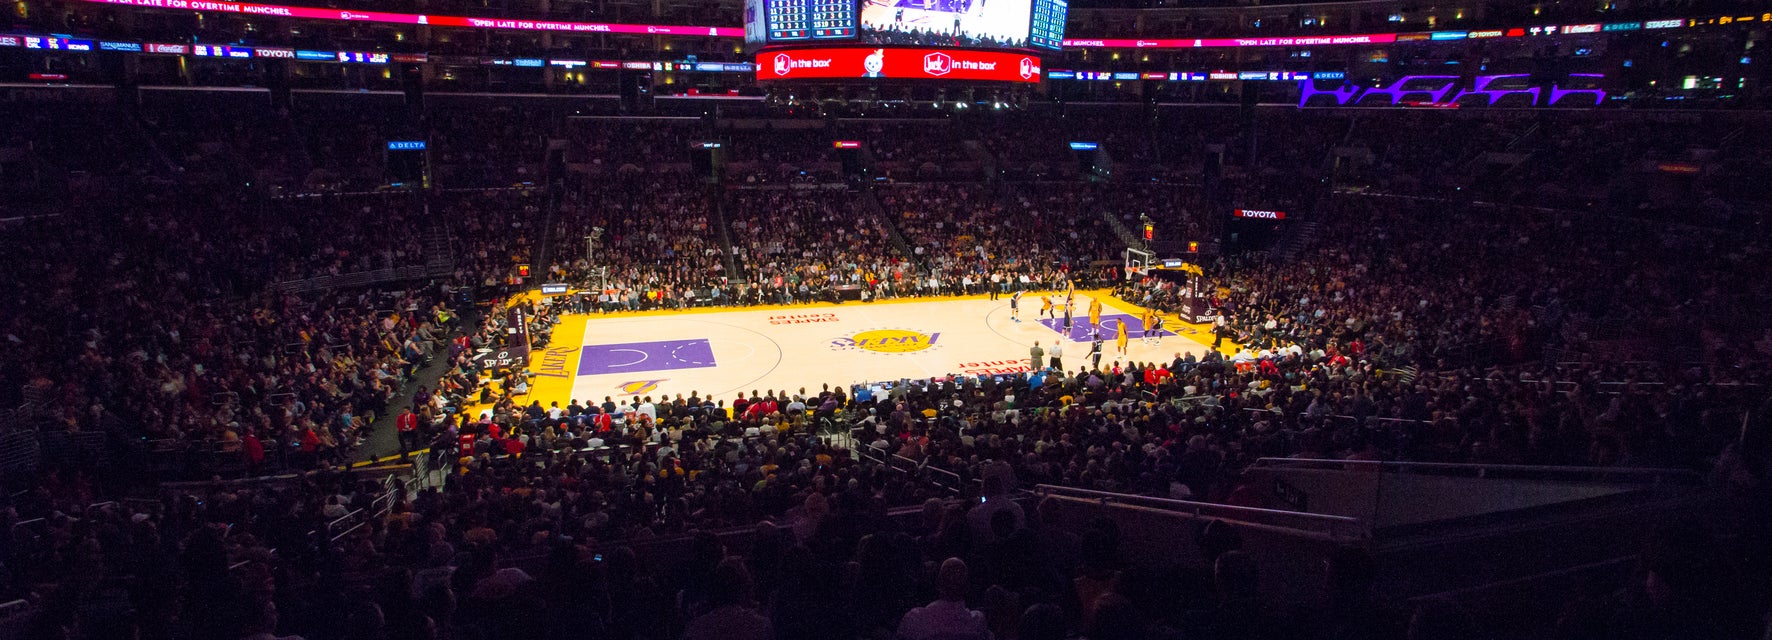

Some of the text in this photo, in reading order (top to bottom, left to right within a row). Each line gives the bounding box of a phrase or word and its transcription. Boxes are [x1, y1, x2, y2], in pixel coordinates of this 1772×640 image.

[167, 0, 187, 8] FOR
[192, 2, 240, 12] OVERTIME
[244, 6, 292, 15] MUNCHIES.
[518, 21, 534, 29] FOR
[574, 24, 611, 32] MUNCHIES.
[1612, 22, 1641, 30] DELTA
[1645, 19, 1682, 28] STAPLES
[256, 49, 295, 58] TOYOTA
[790, 60, 797, 68] in
[798, 59, 811, 68] the
[952, 61, 961, 69] in
[962, 60, 977, 69] the
[1241, 210, 1277, 219] TOYOTA
[769, 317, 840, 325] STAPLES
[831, 332, 941, 348] LAKERS
[534, 346, 580, 379] LAKERS
